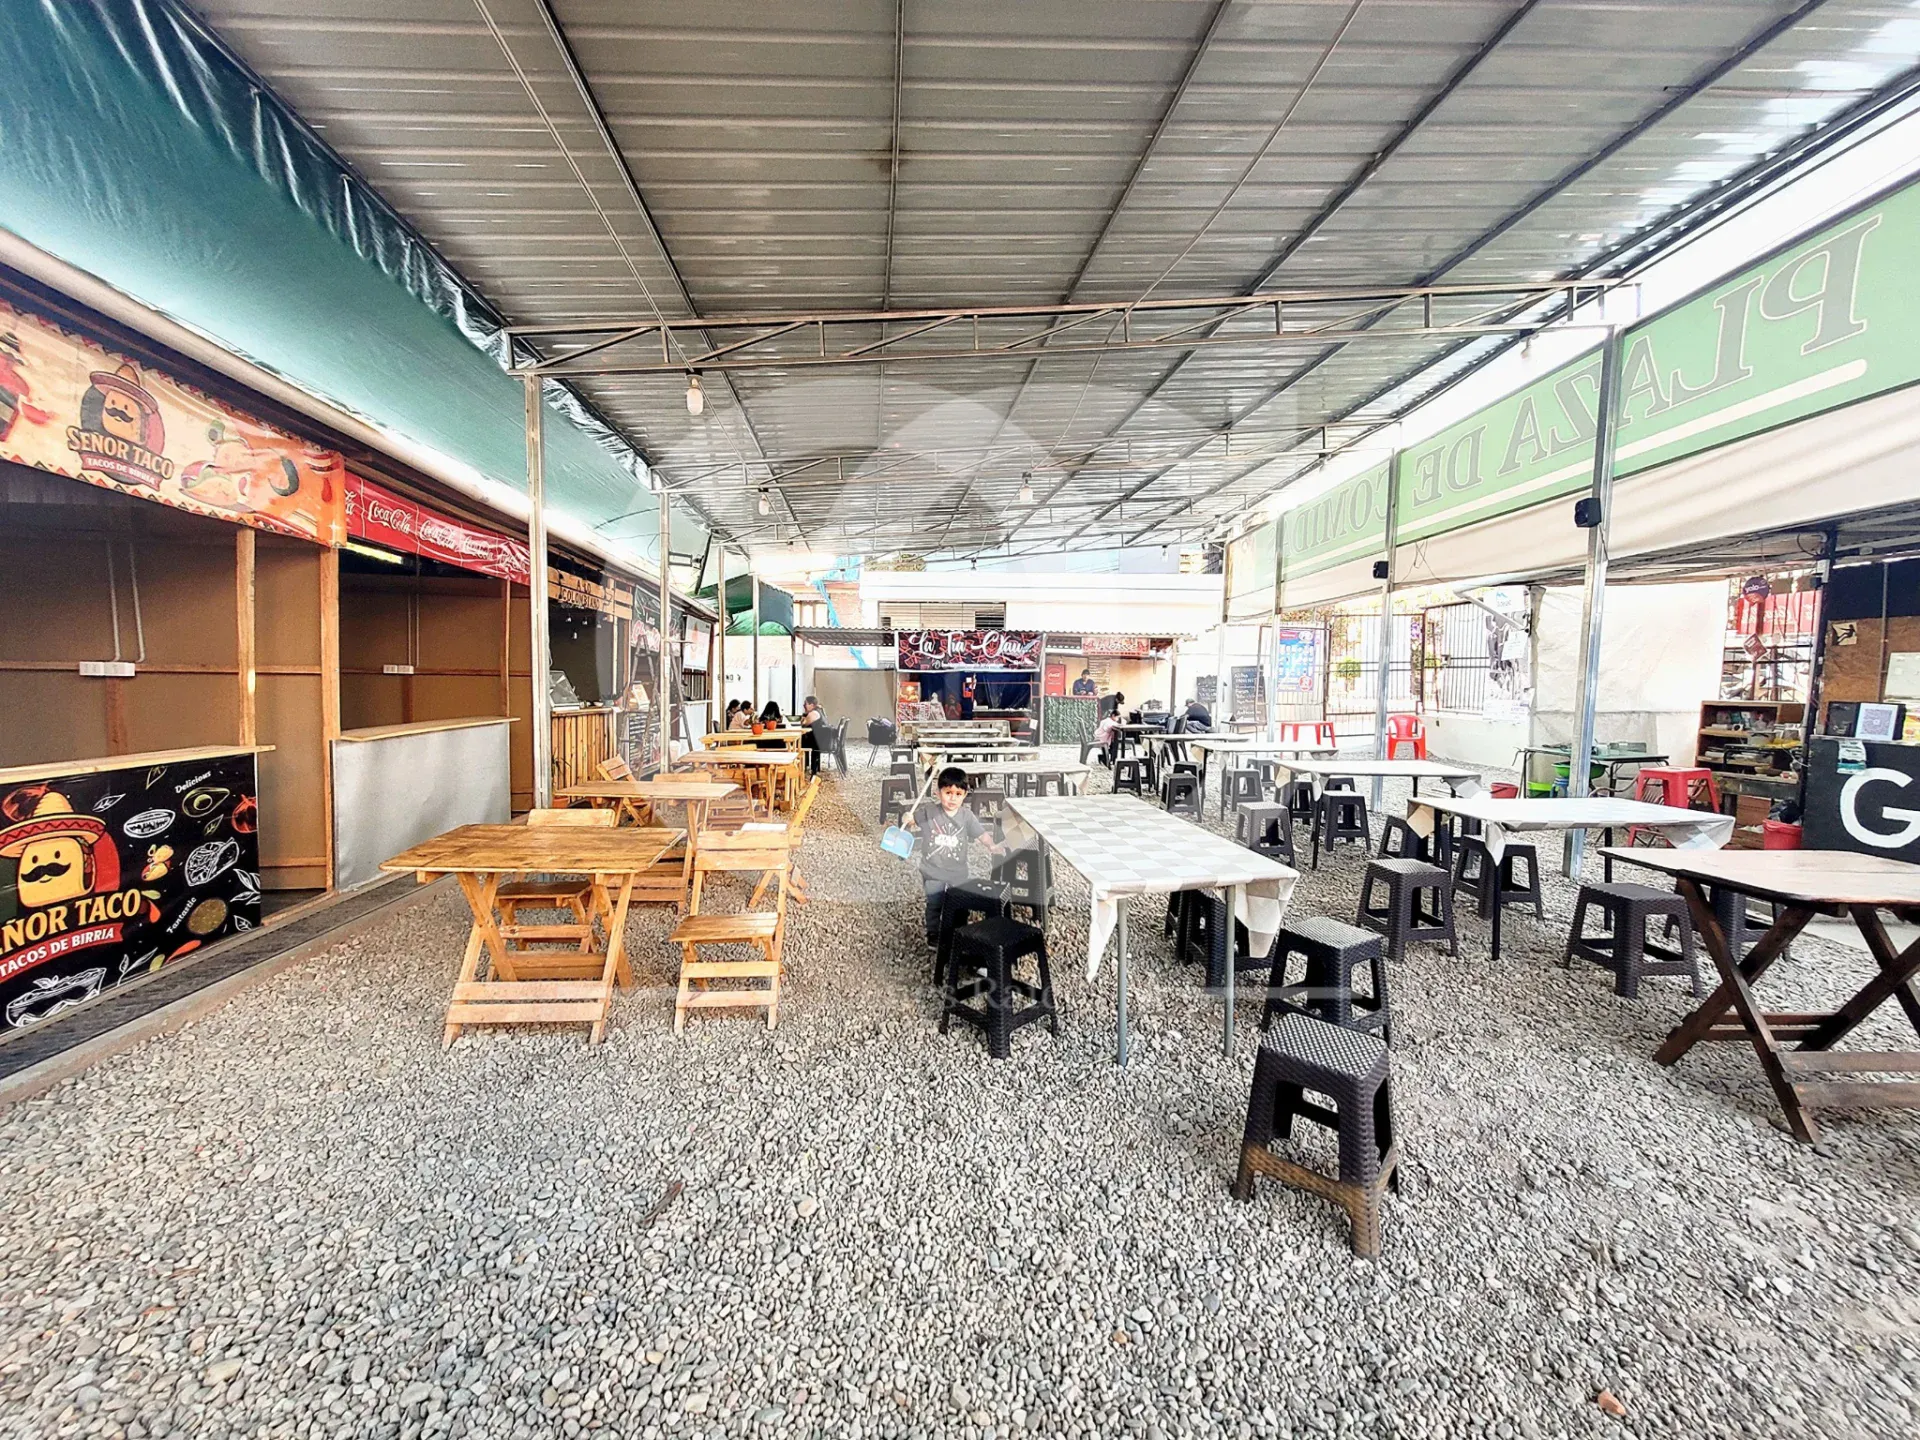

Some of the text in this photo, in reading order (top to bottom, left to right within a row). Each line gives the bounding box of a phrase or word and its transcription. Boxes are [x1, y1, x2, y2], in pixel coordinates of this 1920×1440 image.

[86, 457, 115, 469] TACOS
[116, 464, 127, 473] DE
[132, 446, 175, 480] TACO
[909, 631, 945, 659] La
[174, 770, 212, 794] Delicious
[0, 888, 142, 955] ÑOR TACO
[166, 897, 197, 934] Fantastic
[0, 927, 115, 978] TACOS DE BIRRIA
